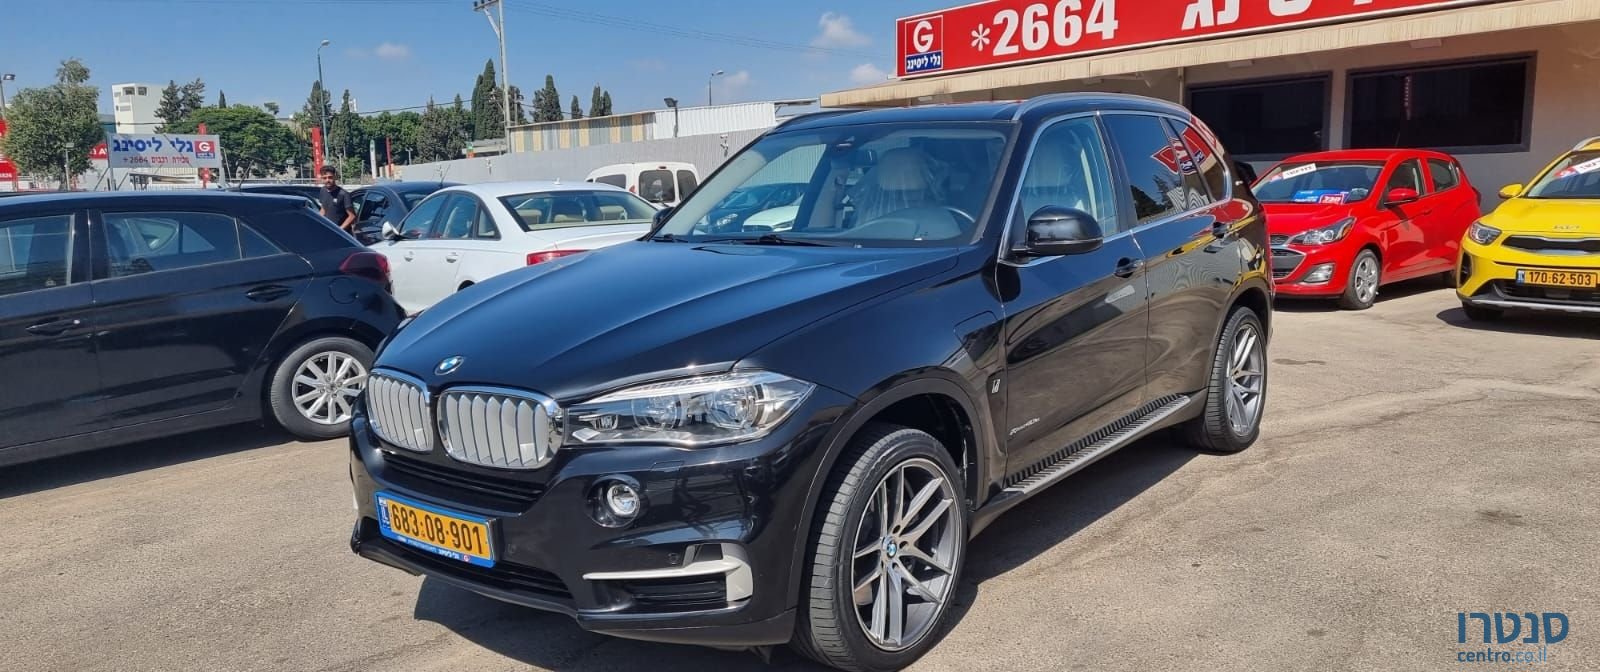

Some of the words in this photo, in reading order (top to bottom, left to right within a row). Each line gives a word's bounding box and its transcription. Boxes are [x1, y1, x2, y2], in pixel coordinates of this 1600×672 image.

[913, 20, 934, 53] G
[113, 137, 163, 153] ליסינג
[170, 137, 194, 153] גלי
[198, 141, 211, 152] G
